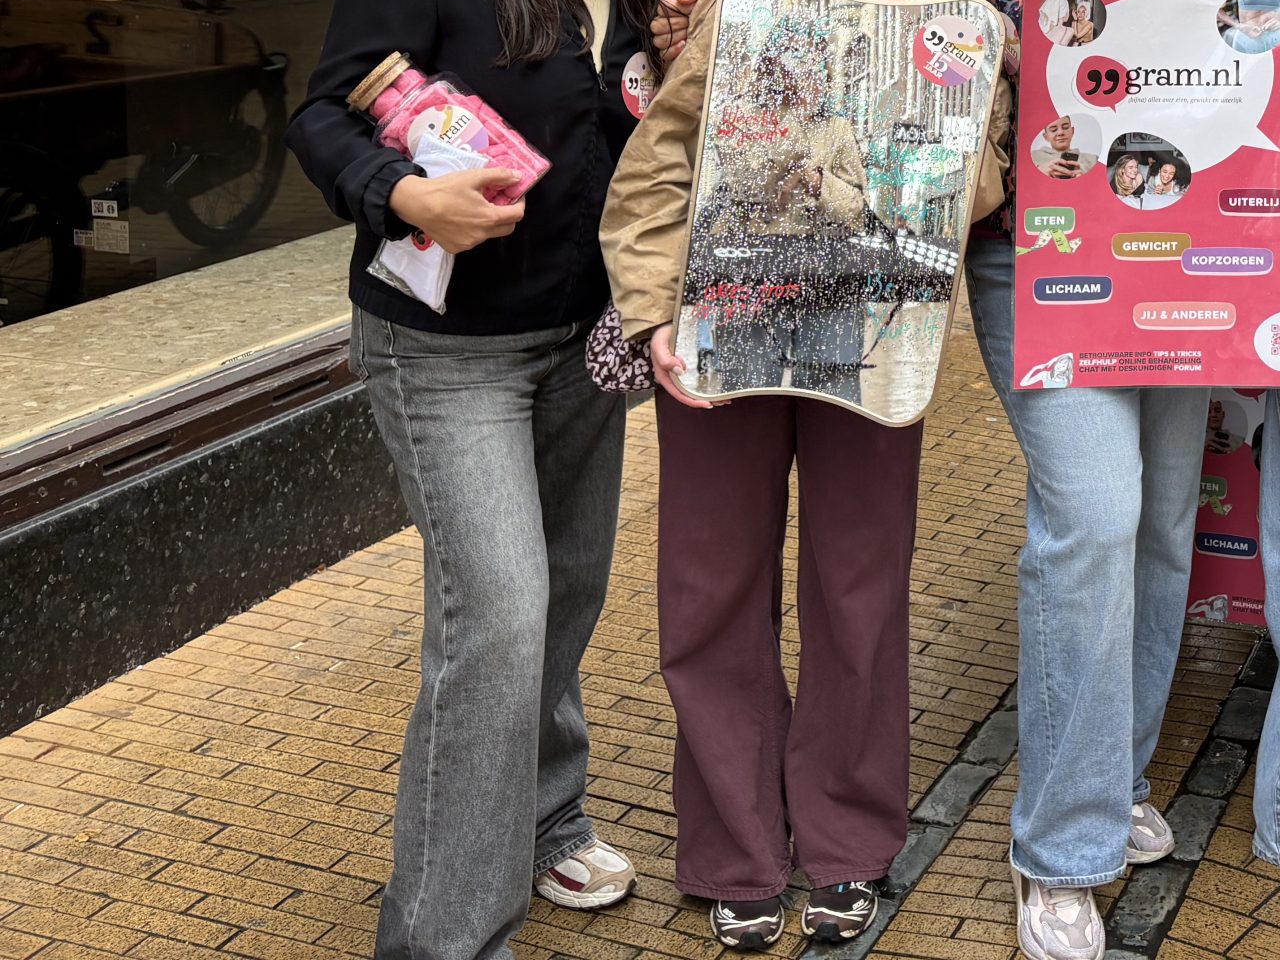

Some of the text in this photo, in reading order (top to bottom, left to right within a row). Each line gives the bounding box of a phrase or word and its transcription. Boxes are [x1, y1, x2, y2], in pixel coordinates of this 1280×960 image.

[923, 62, 943, 79] JAAR
[1034, 216, 1065, 226] ETEN
[1122, 241, 1178, 251] GEWICHT
[1191, 255, 1265, 266] KOPZORGEN
[1045, 283, 1101, 294] LICHAAM
[1140, 310, 1229, 320] JIJ & ANDEREN
[1079, 351, 1134, 359] BETROUWBARE
[1200, 482, 1219, 491] TEN
[1204, 538, 1249, 551] LICHAAM
[1232, 601, 1263, 610] ZELFHULP
